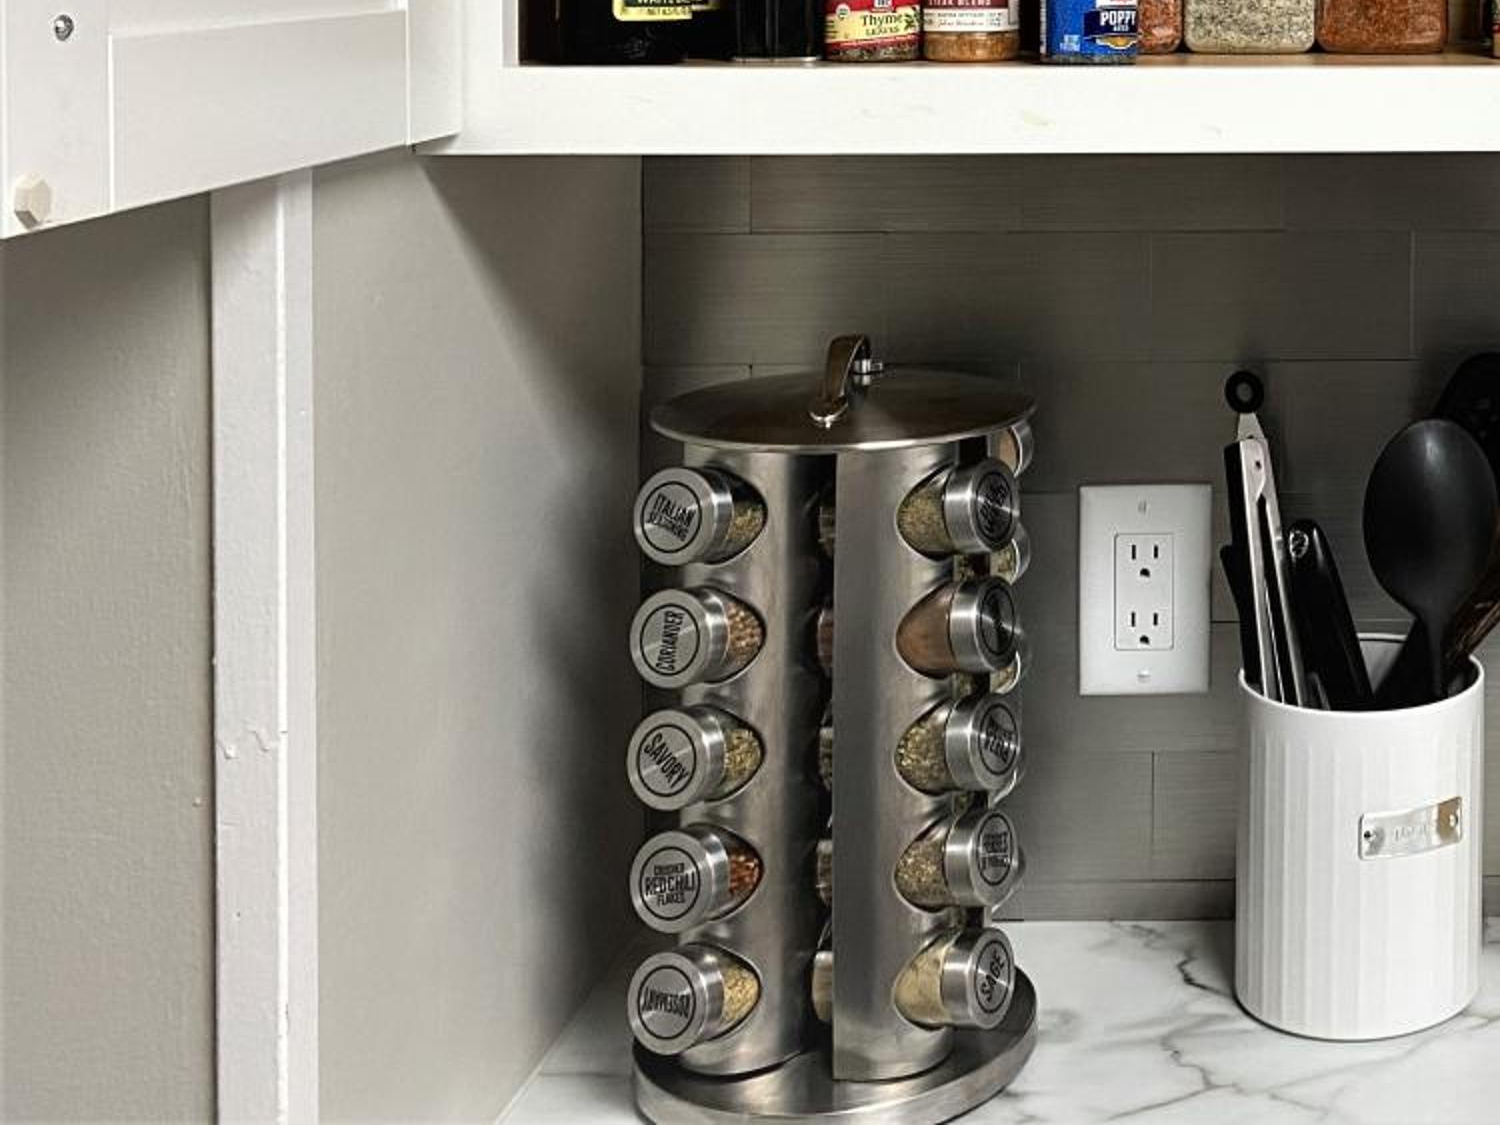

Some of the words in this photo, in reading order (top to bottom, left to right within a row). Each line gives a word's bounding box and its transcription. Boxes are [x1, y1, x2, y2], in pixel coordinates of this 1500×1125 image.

[861, 13, 903, 28] Thyme
[1100, 10, 1138, 26] POPPY
[650, 492, 698, 529] ITALIAN
[655, 610, 685, 672] CORIANDER
[643, 732, 689, 789] SAVORY
[981, 947, 1006, 1003] SAGE
